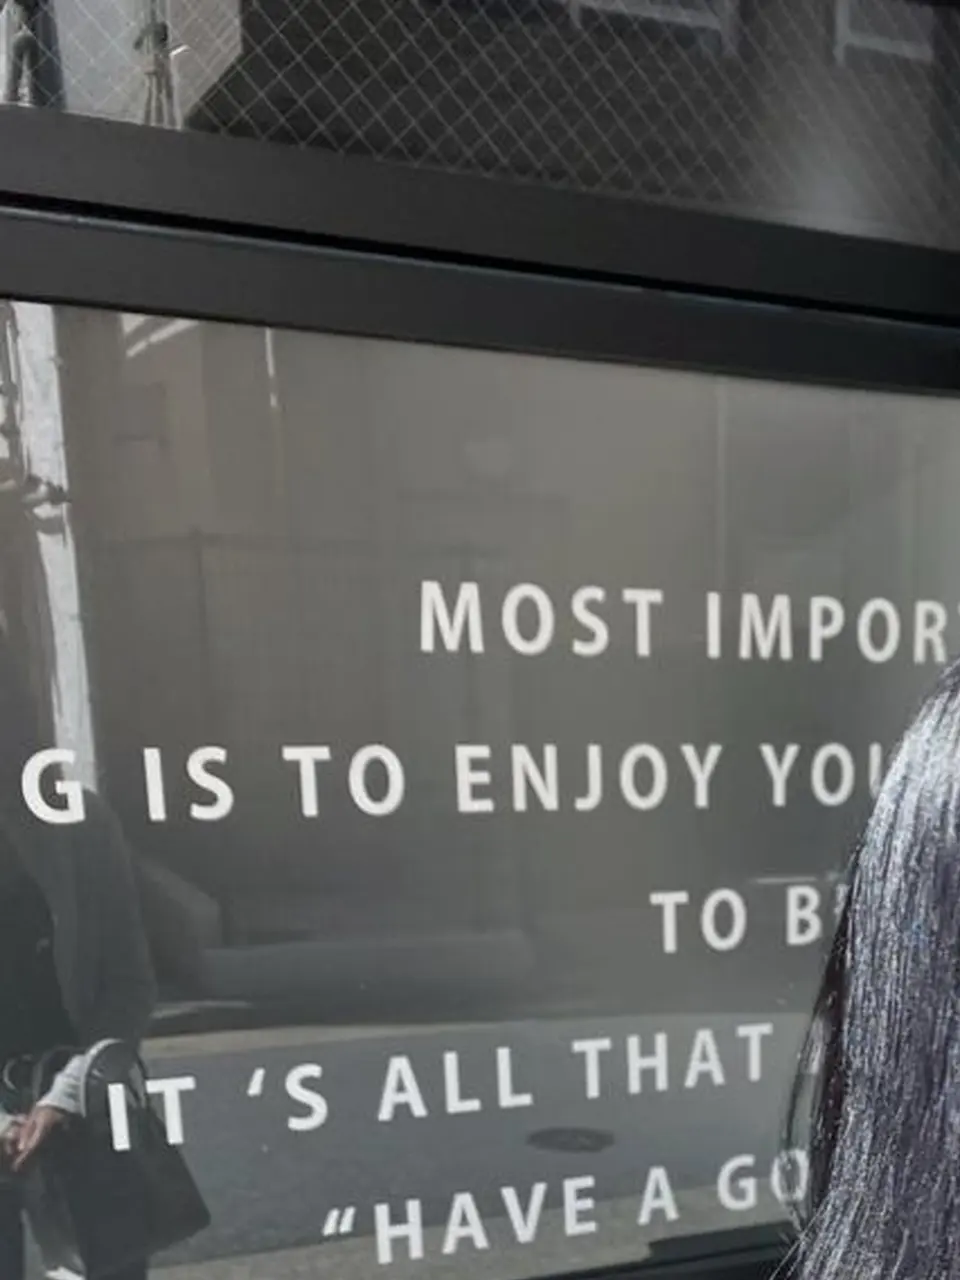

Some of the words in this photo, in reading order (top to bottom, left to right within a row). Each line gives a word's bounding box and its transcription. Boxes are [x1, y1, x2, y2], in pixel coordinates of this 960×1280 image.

[420, 580, 664, 656] MOST
[143, 746, 235, 822] IS
[282, 744, 405, 818] TO
[454, 743, 723, 813] ENJOY
[650, 888, 748, 953] TO
[107, 1076, 196, 1151] IT
[378, 1047, 533, 1122] ALL
[572, 1022, 774, 1099] THAT
[637, 1166, 679, 1226] A
